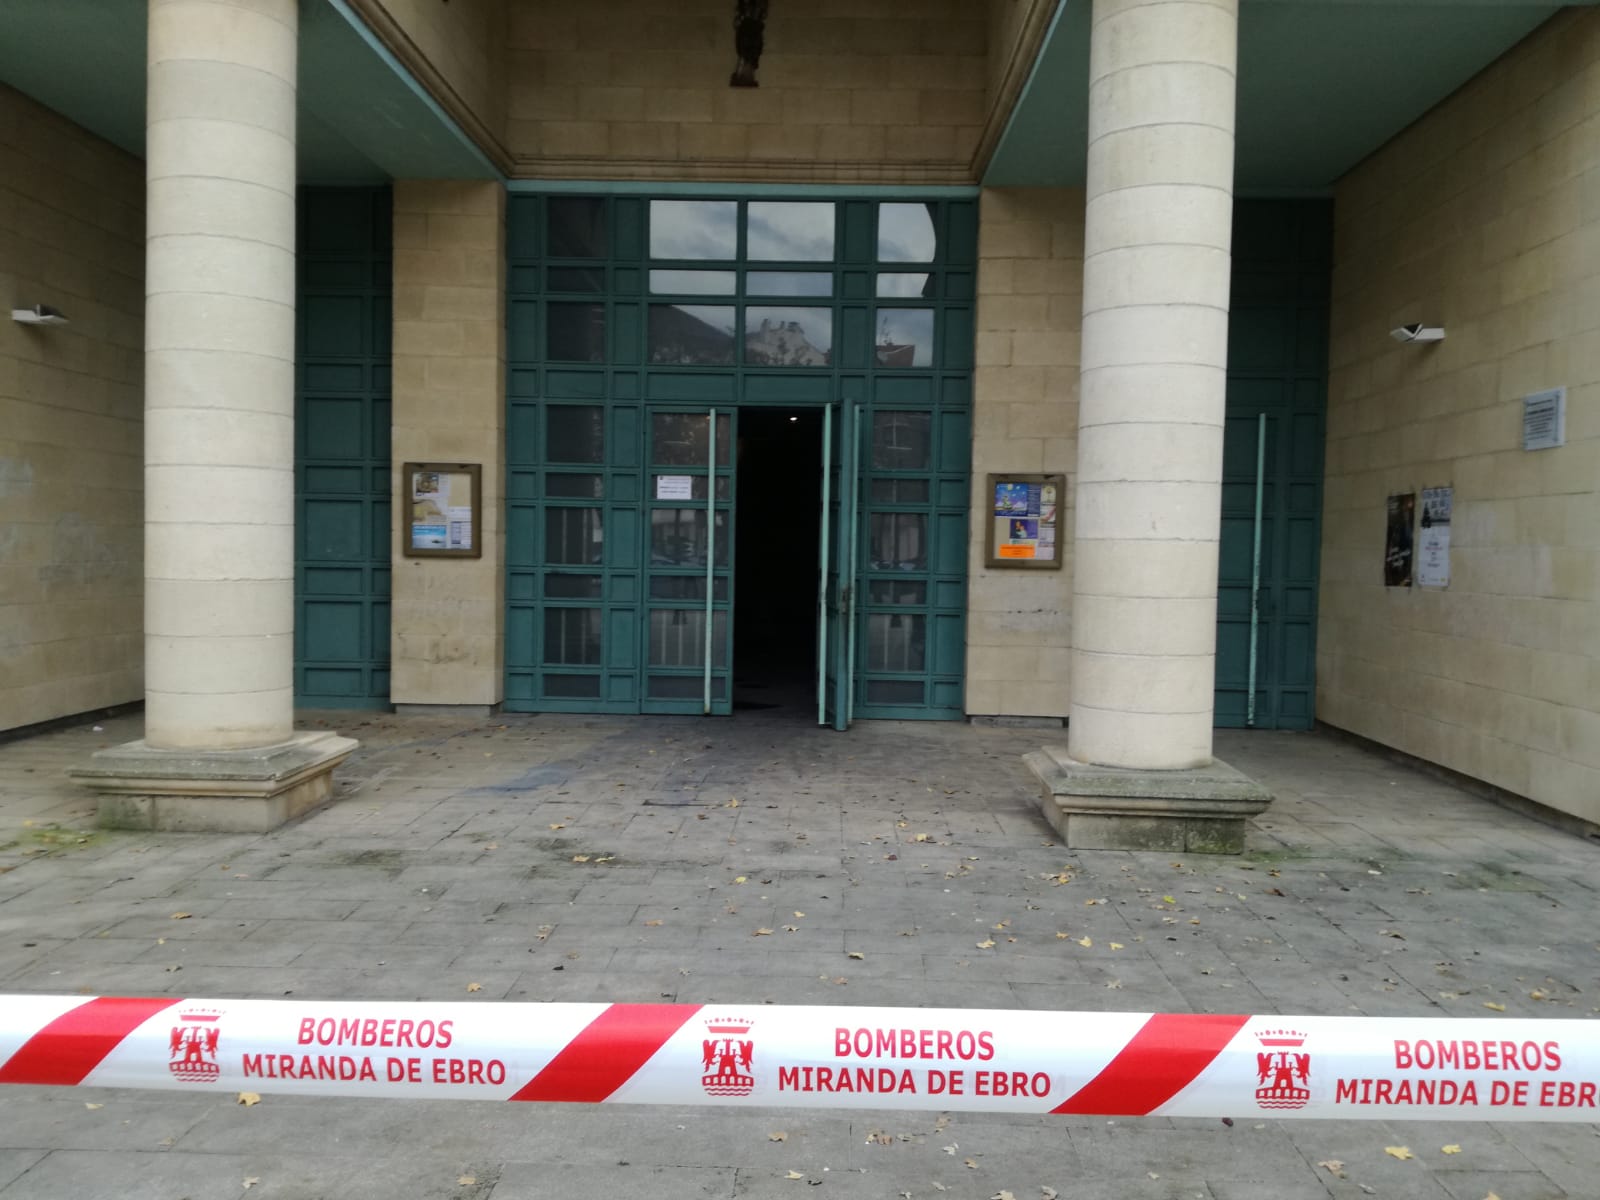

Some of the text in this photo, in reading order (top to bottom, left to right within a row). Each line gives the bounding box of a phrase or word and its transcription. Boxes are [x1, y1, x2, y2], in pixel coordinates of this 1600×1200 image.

[297, 1017, 454, 1050] BOMBEROS
[834, 1027, 995, 1062] BOMBEROS
[242, 1053, 506, 1086] MIRANDA DE EBRO
[1394, 1039, 1562, 1072] BOMBEROS
[778, 1066, 1051, 1099] MIRANDA DE EBRO
[1335, 1078, 1600, 1108] MIRANDA DE EBR
